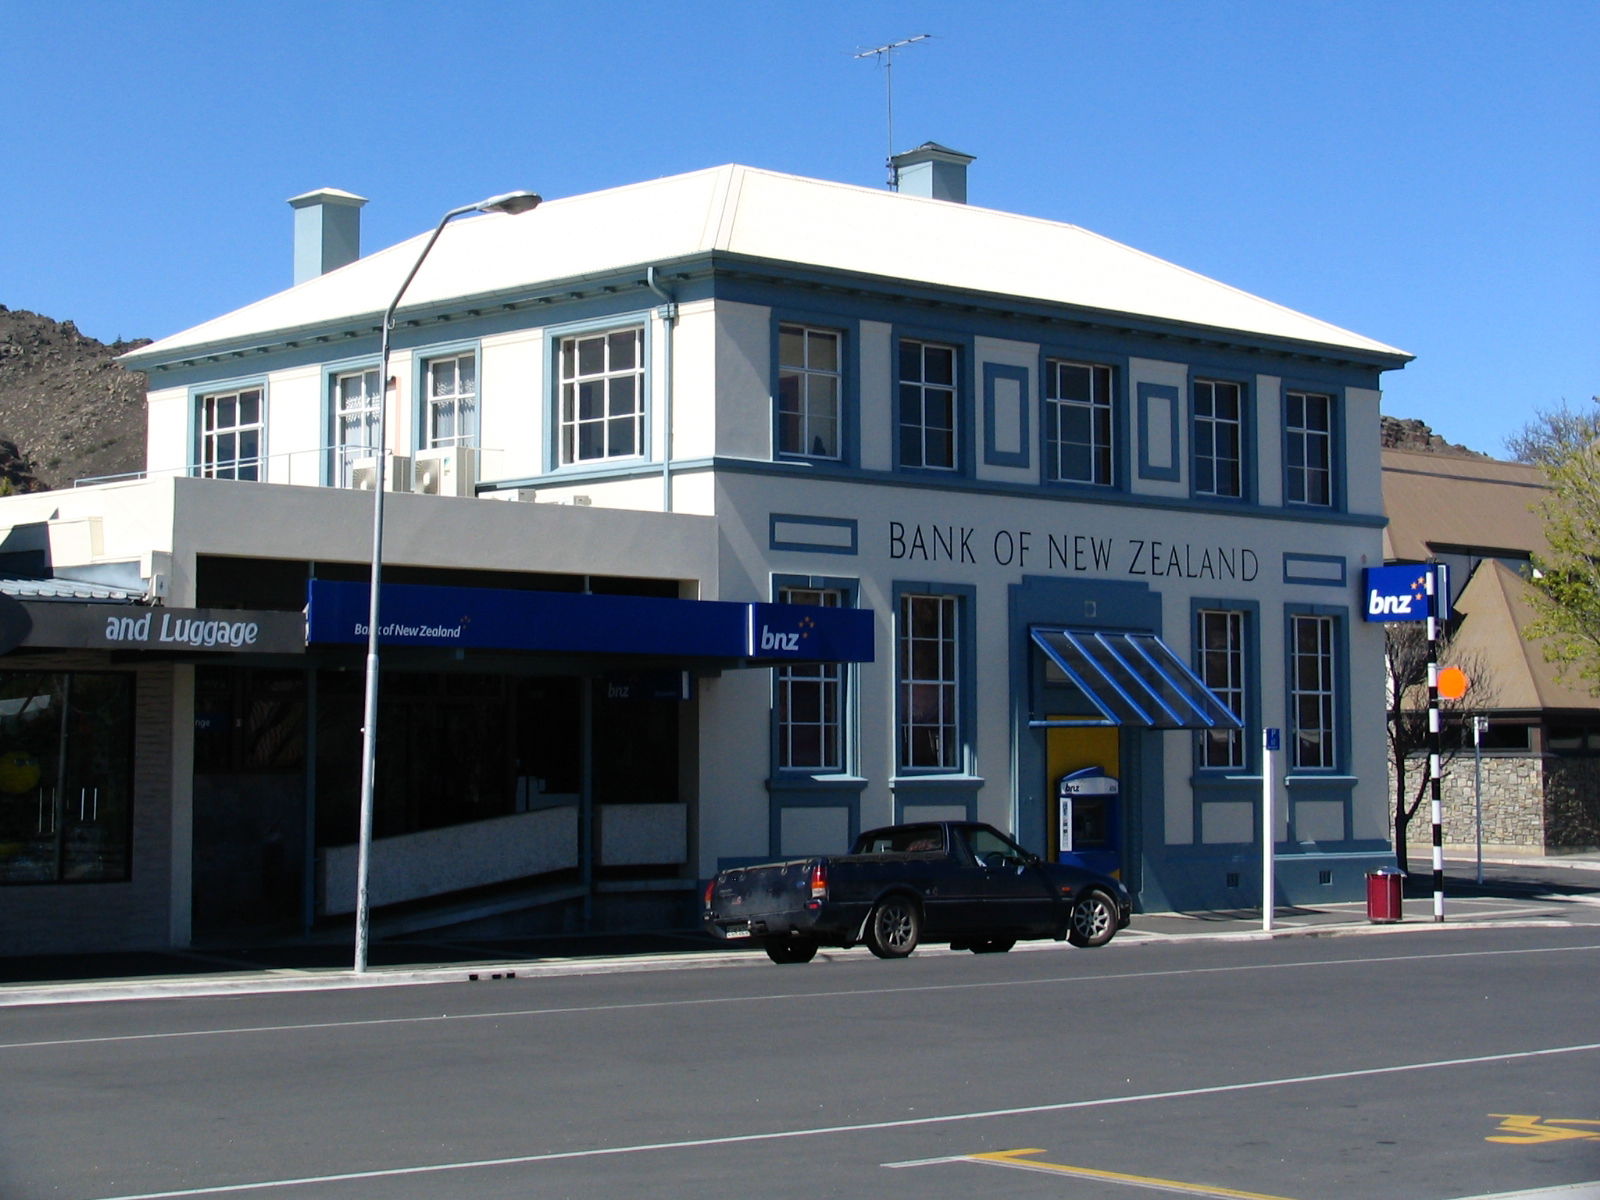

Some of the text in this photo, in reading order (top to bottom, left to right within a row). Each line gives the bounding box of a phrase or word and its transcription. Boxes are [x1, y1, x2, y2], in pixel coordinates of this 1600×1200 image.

[889, 521, 1259, 582] BANK OF NEW ZEALAND
[1369, 589, 1412, 615] bnz
[105, 612, 259, 647] and Luggage
[382, 623, 396, 636] of
[395, 624, 420, 637] New
[420, 625, 461, 638] Zealand
[761, 624, 800, 651] bnz
[607, 681, 630, 699] bnz
